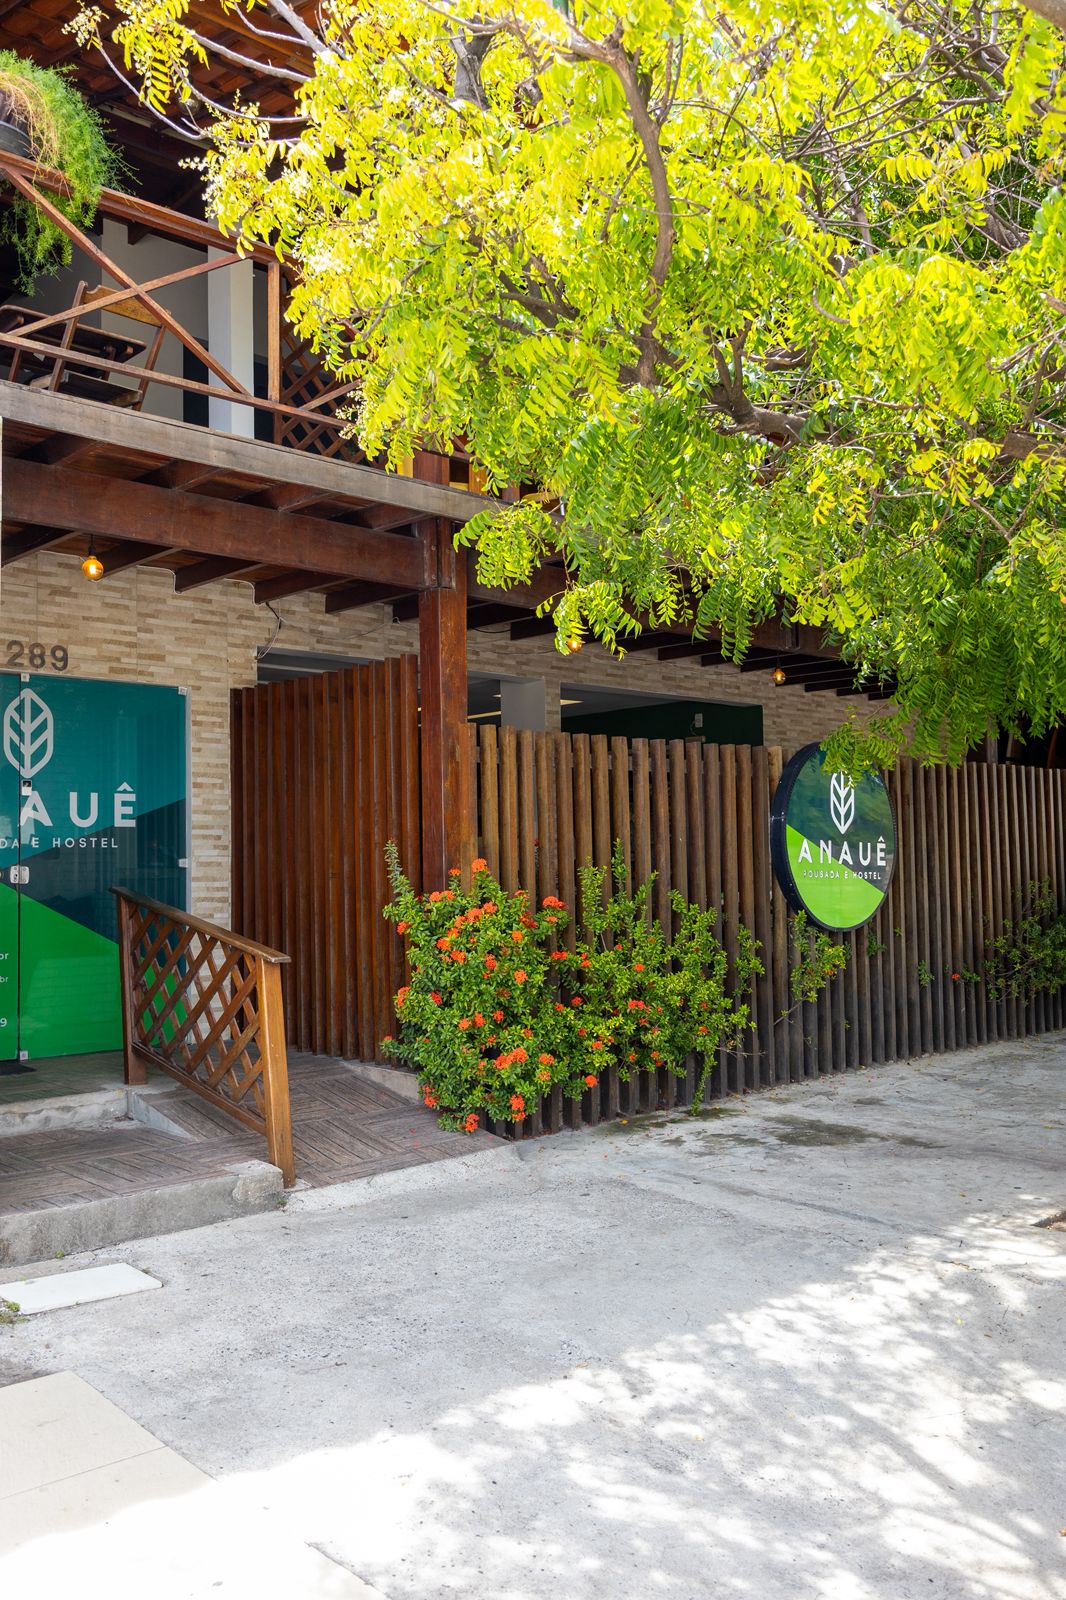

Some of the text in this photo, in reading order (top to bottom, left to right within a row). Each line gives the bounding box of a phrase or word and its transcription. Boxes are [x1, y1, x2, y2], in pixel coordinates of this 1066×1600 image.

[6, 640, 69, 671] 289
[17, 782, 137, 828] AUÊ
[31, 837, 40, 848] E
[52, 837, 119, 848] HOSTEL
[798, 836, 887, 866] ANAUÊ
[803, 869, 882, 880] POUSADA E HOSTEL
